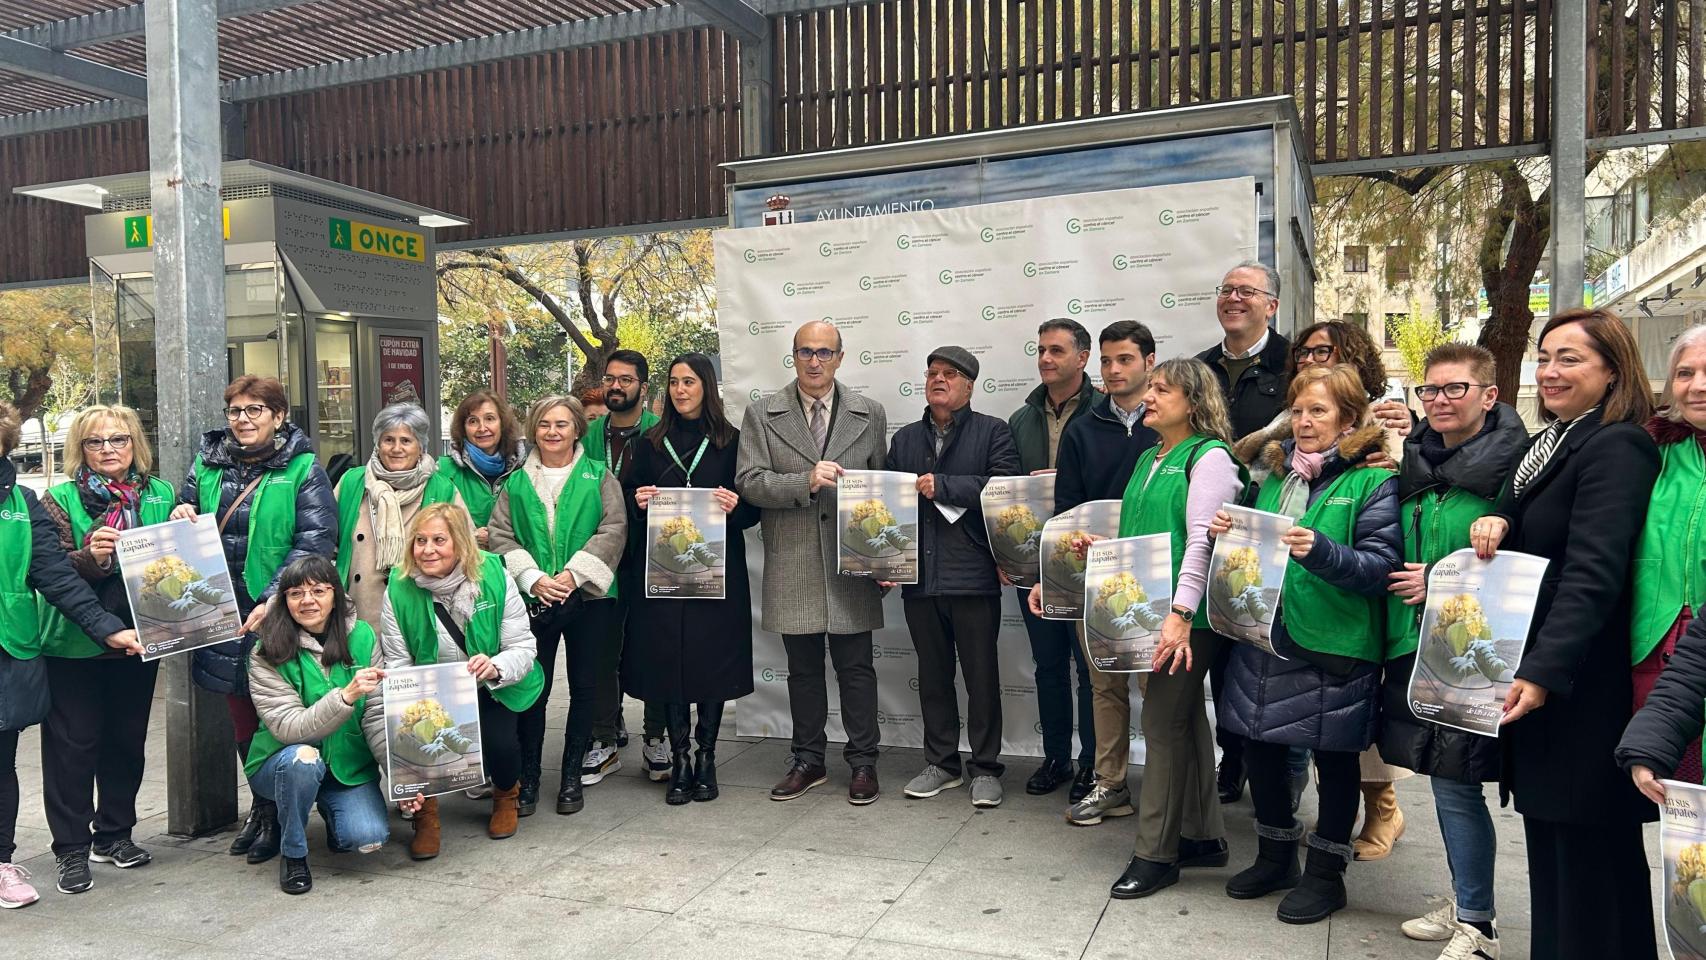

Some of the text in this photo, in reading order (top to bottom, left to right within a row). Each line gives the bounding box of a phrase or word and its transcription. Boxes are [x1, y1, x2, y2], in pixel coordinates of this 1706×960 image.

[816, 199, 934, 222] AYUNTAMIENTO
[360, 229, 417, 257] ONCE
[401, 340, 420, 348] EXTRA
[1434, 569, 1460, 578] zapatos
[1675, 800, 1690, 808] sus
[1665, 806, 1698, 819] zapatos
